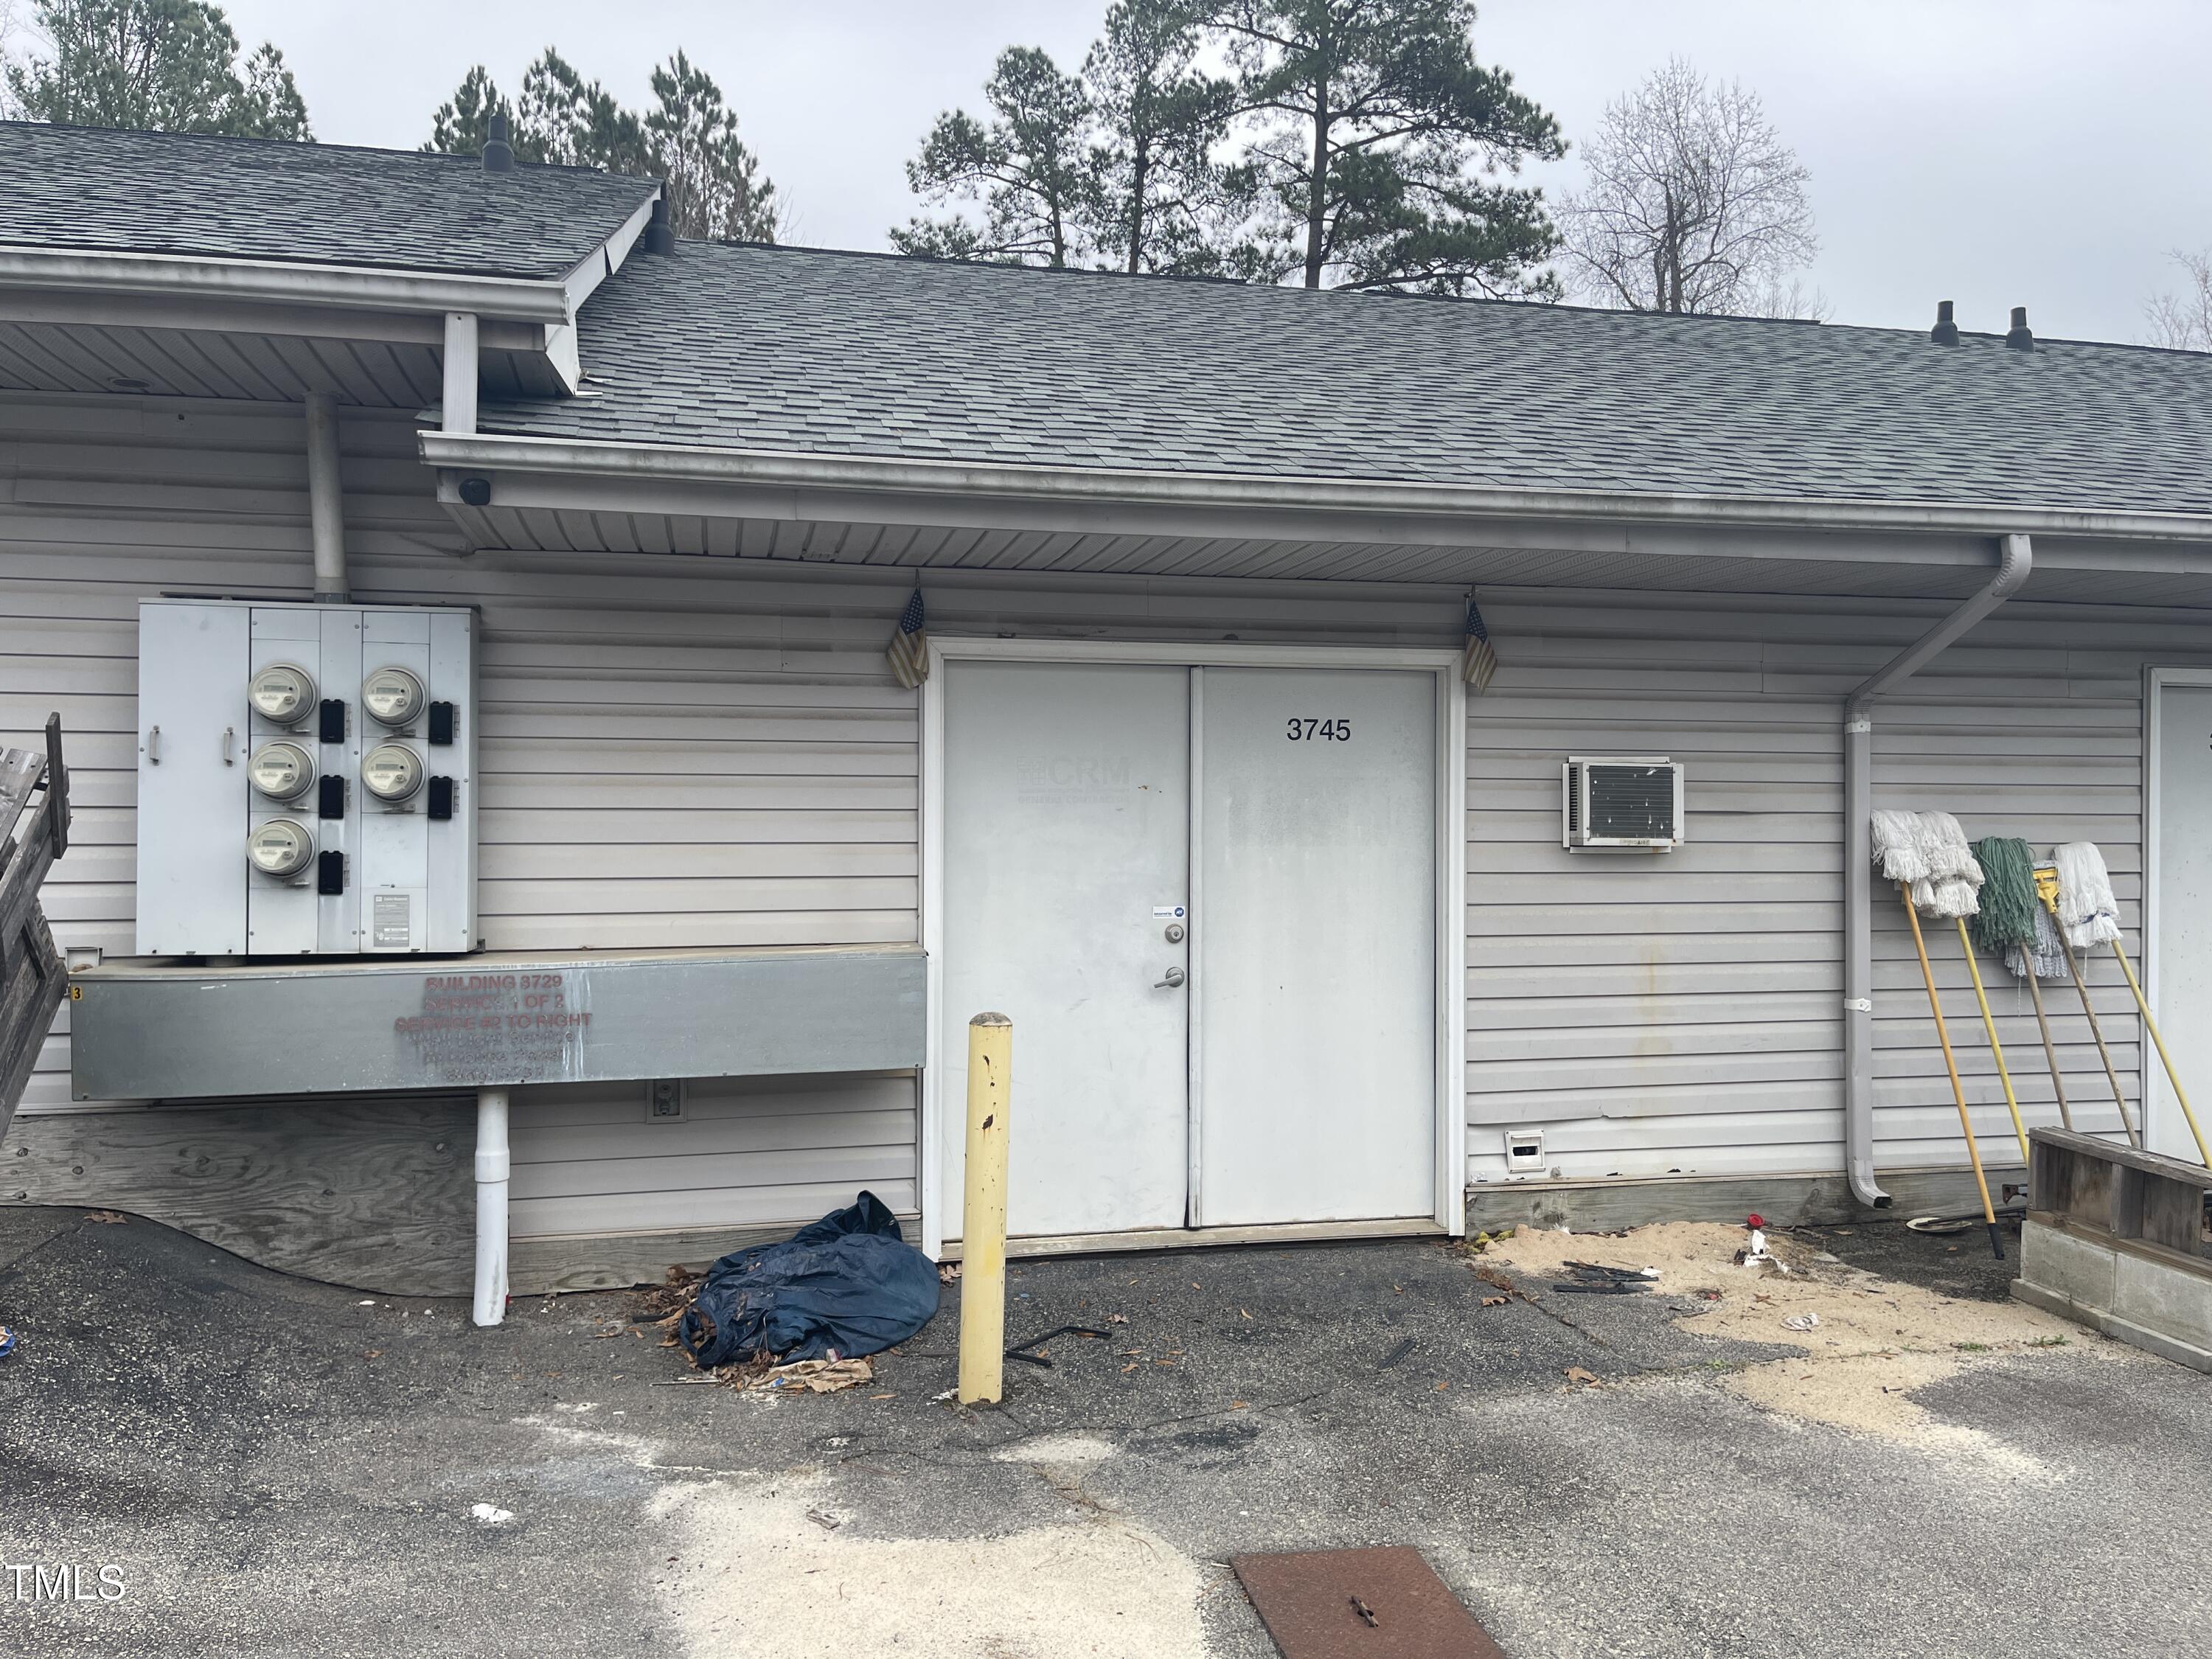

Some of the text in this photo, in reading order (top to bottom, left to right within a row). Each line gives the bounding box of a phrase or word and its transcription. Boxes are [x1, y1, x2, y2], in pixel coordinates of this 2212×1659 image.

[1287, 717, 1351, 742] 3745
[1048, 756, 1130, 785] CRM
[426, 974, 563, 992] BUILDING 3729
[74, 987, 80, 999] 3
[524, 994, 549, 1008] OF
[394, 1015, 477, 1033] SERVICE
[507, 1013, 532, 1029] TO
[536, 1012, 592, 1028] RIGHT
